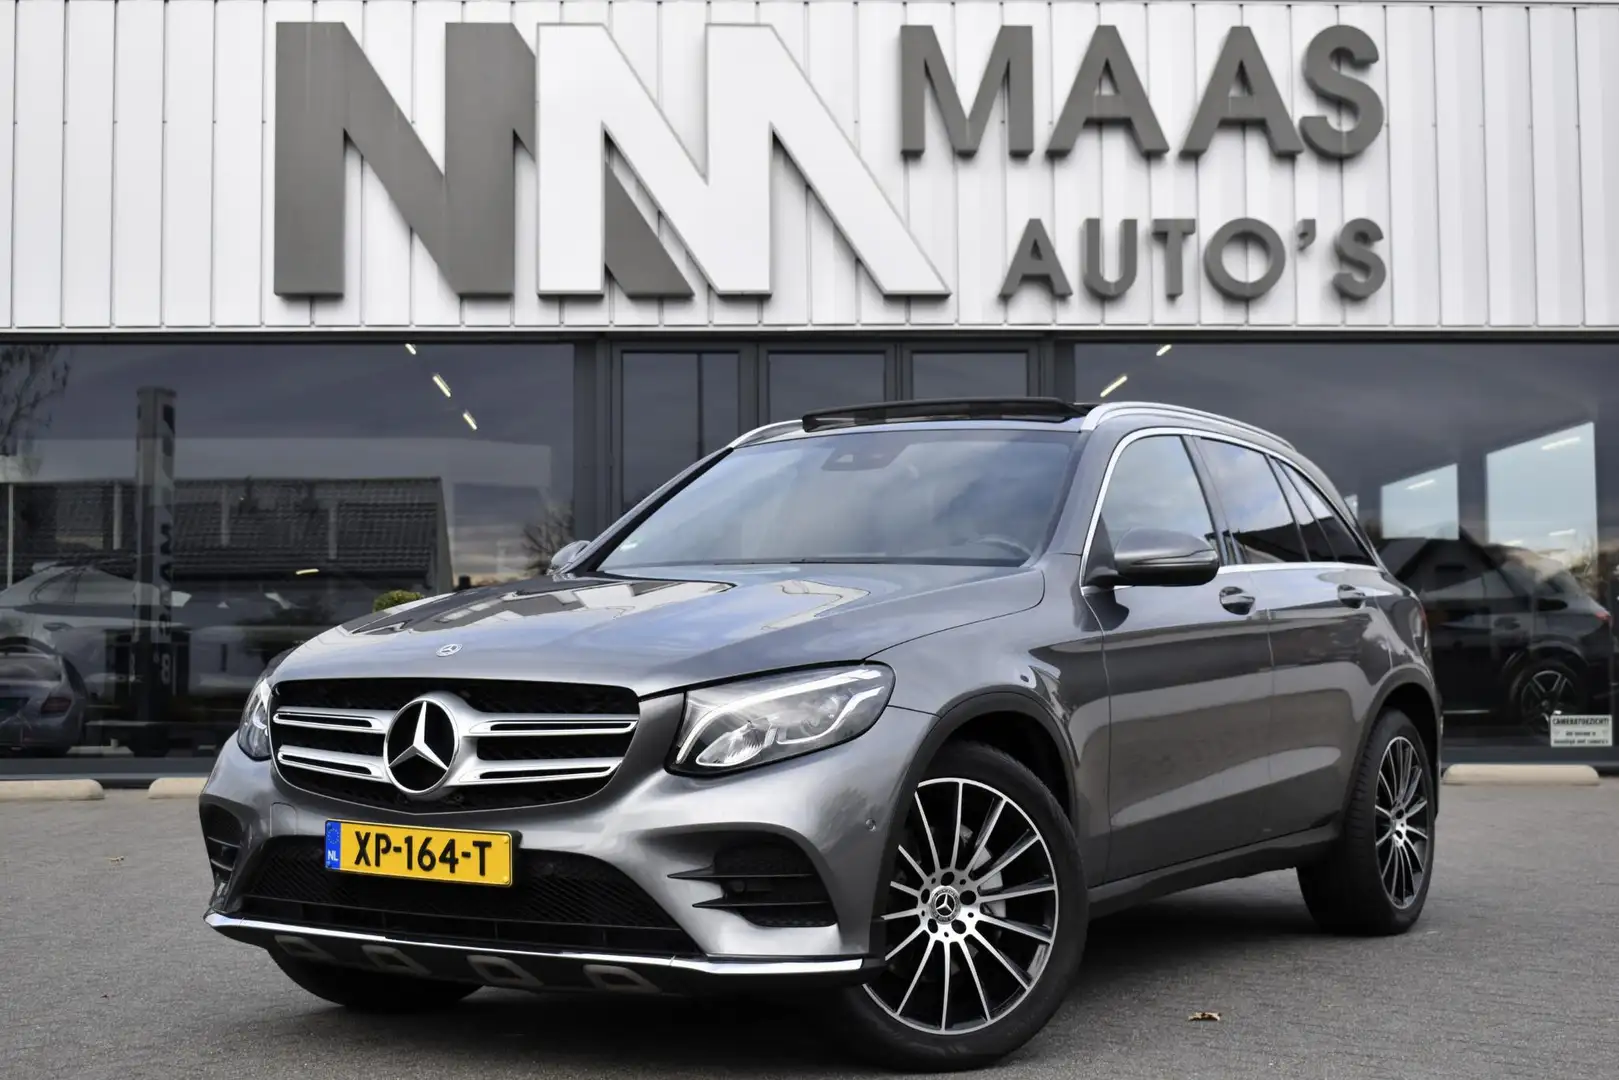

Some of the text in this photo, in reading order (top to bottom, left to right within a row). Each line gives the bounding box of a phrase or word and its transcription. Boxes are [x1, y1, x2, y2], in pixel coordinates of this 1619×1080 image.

[898, 25, 1385, 160] MAAS
[998, 217, 1387, 301] AUTO'S
[327, 849, 339, 862] NL
[354, 831, 492, 876] XP-164-T
